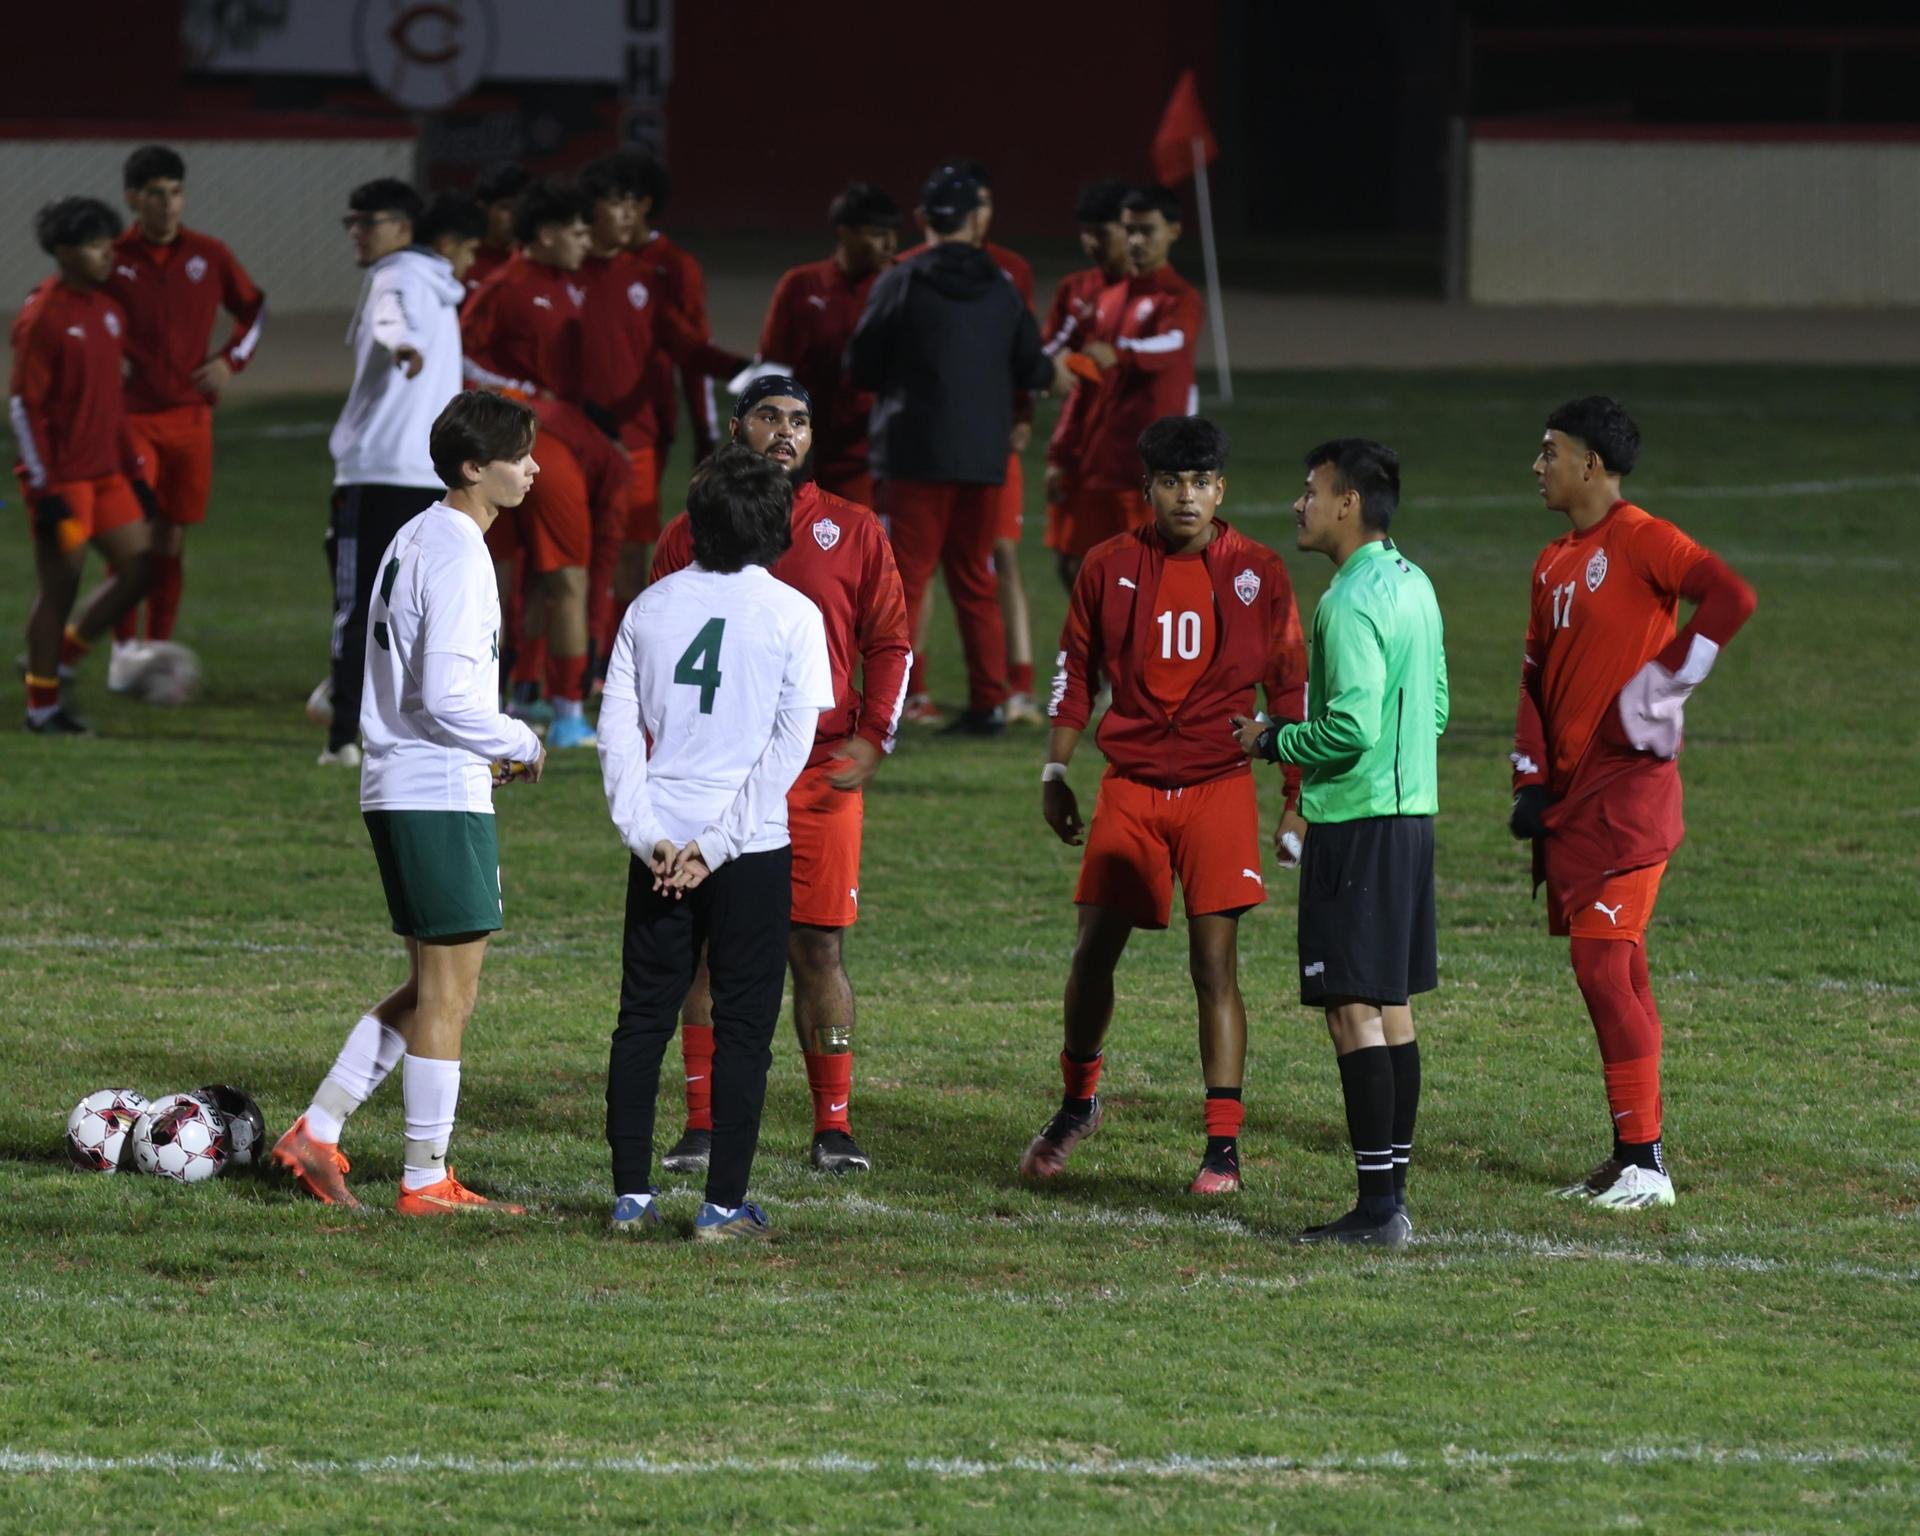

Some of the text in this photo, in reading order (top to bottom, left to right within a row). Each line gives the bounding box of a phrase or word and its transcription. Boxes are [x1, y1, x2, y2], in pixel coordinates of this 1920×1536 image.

[388, 5, 462, 61] C
[1553, 581, 1576, 629] 11
[1157, 610, 1201, 660] 10
[673, 617, 726, 715] 4
